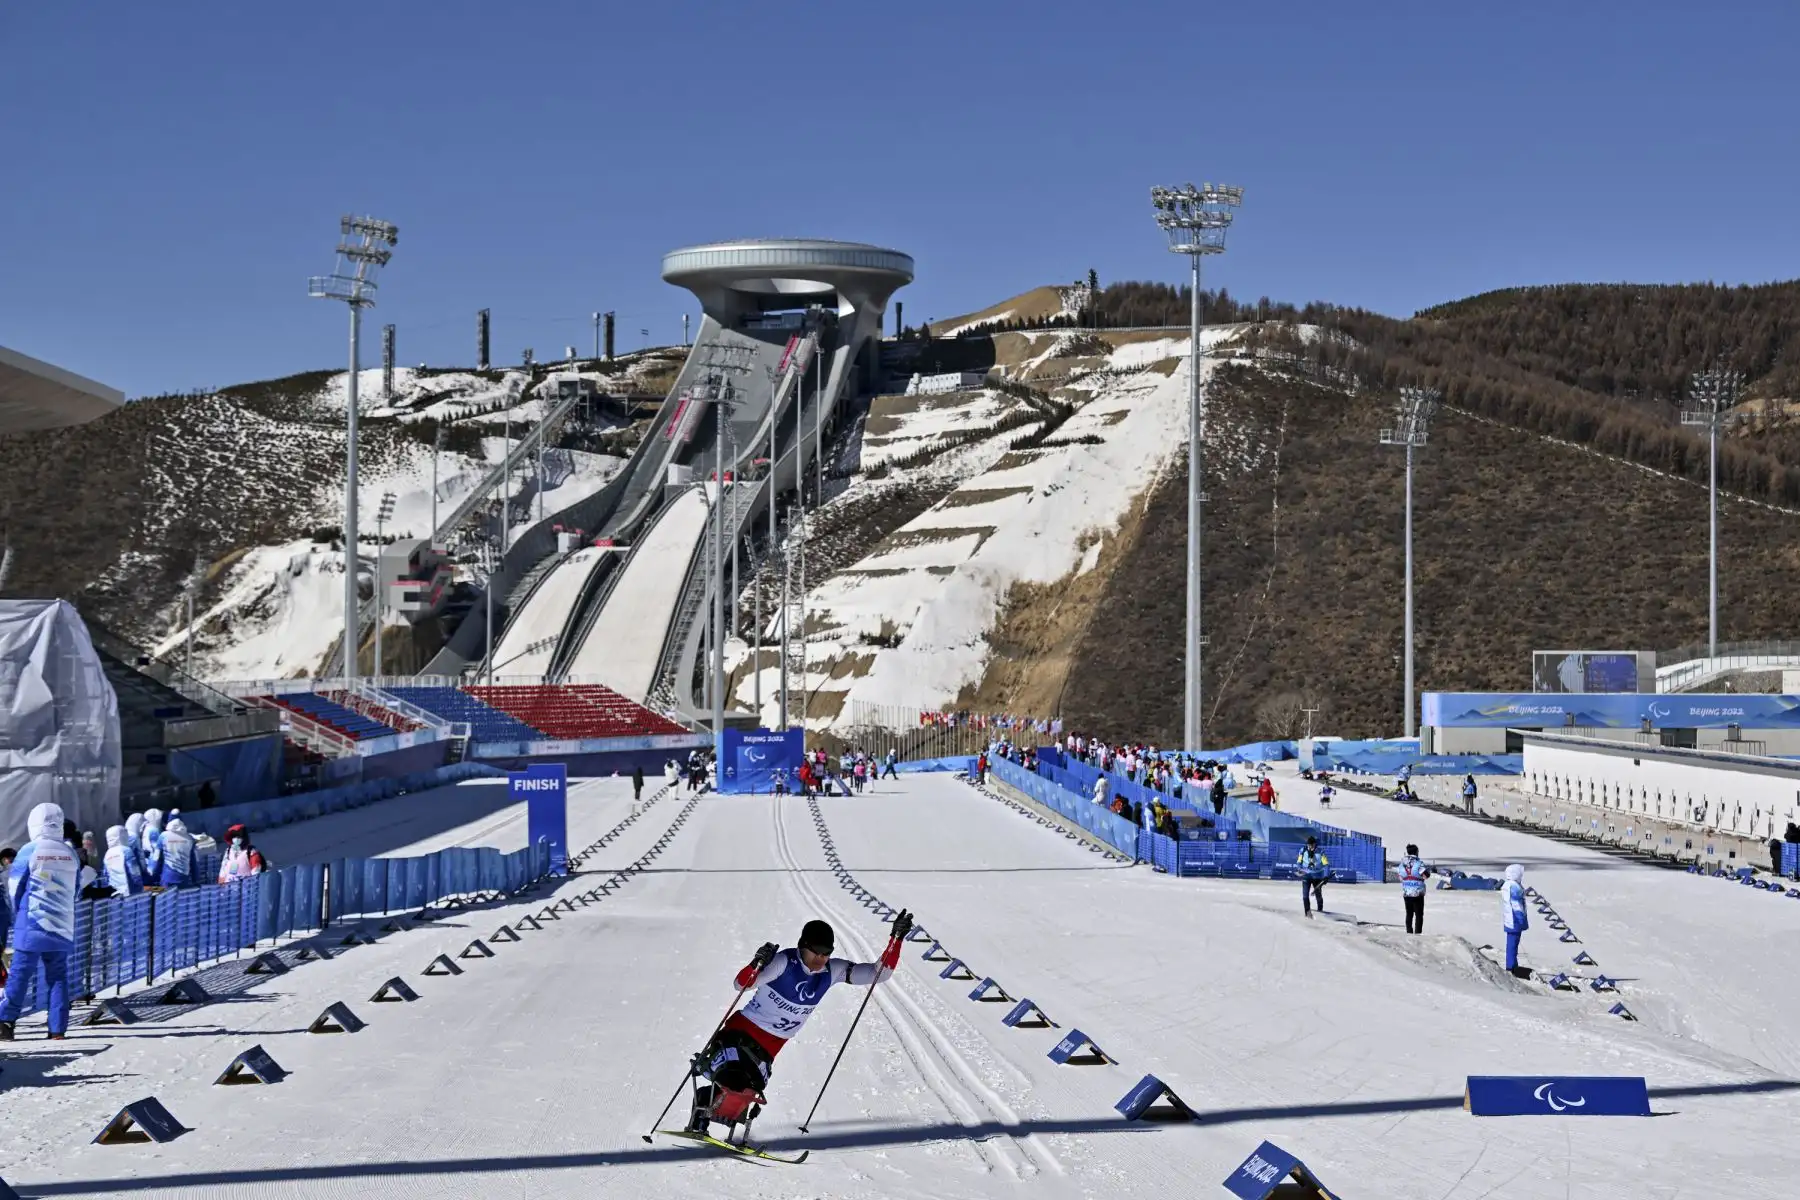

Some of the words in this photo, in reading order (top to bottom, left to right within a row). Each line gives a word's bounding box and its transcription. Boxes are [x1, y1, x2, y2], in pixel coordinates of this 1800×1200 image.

[1508, 705, 1539, 714] BEIJING
[1541, 706, 1564, 714] 2022
[1690, 707, 1719, 716] BEIJING
[1722, 707, 1745, 716] 2022
[514, 779, 559, 791] FINISH
[768, 990, 802, 1015] BEIJING
[773, 1017, 801, 1032] 37
